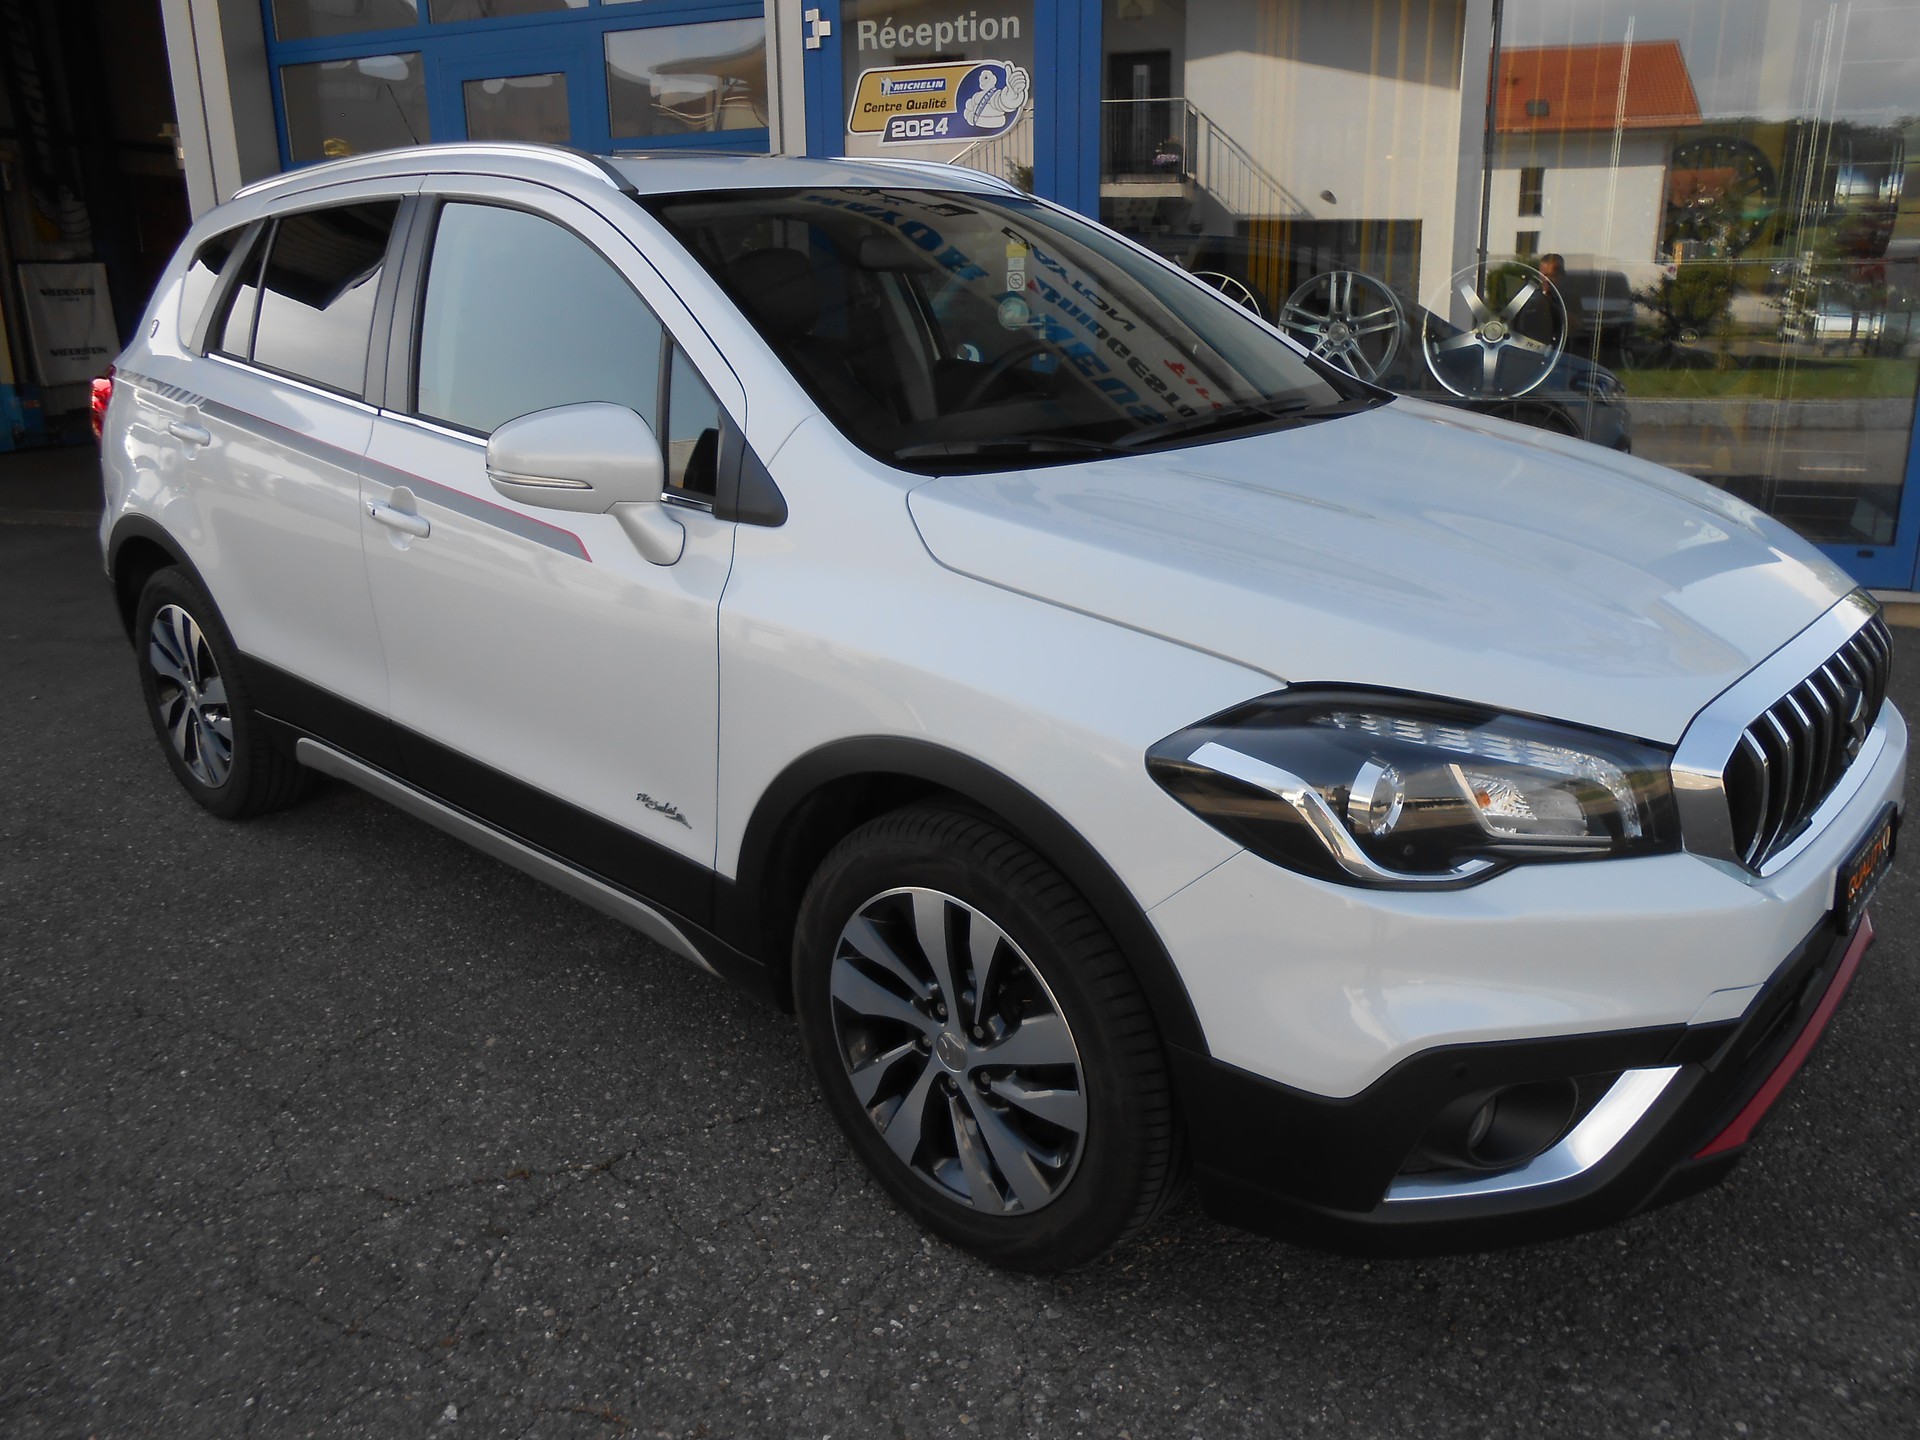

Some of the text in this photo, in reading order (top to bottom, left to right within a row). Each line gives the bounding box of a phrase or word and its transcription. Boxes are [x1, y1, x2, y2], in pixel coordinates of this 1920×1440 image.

[857, 11, 1020, 51] Réception
[893, 80, 944, 91] MICHELIN
[863, 98, 947, 113] Centre Qualité
[891, 117, 949, 137] 2024
